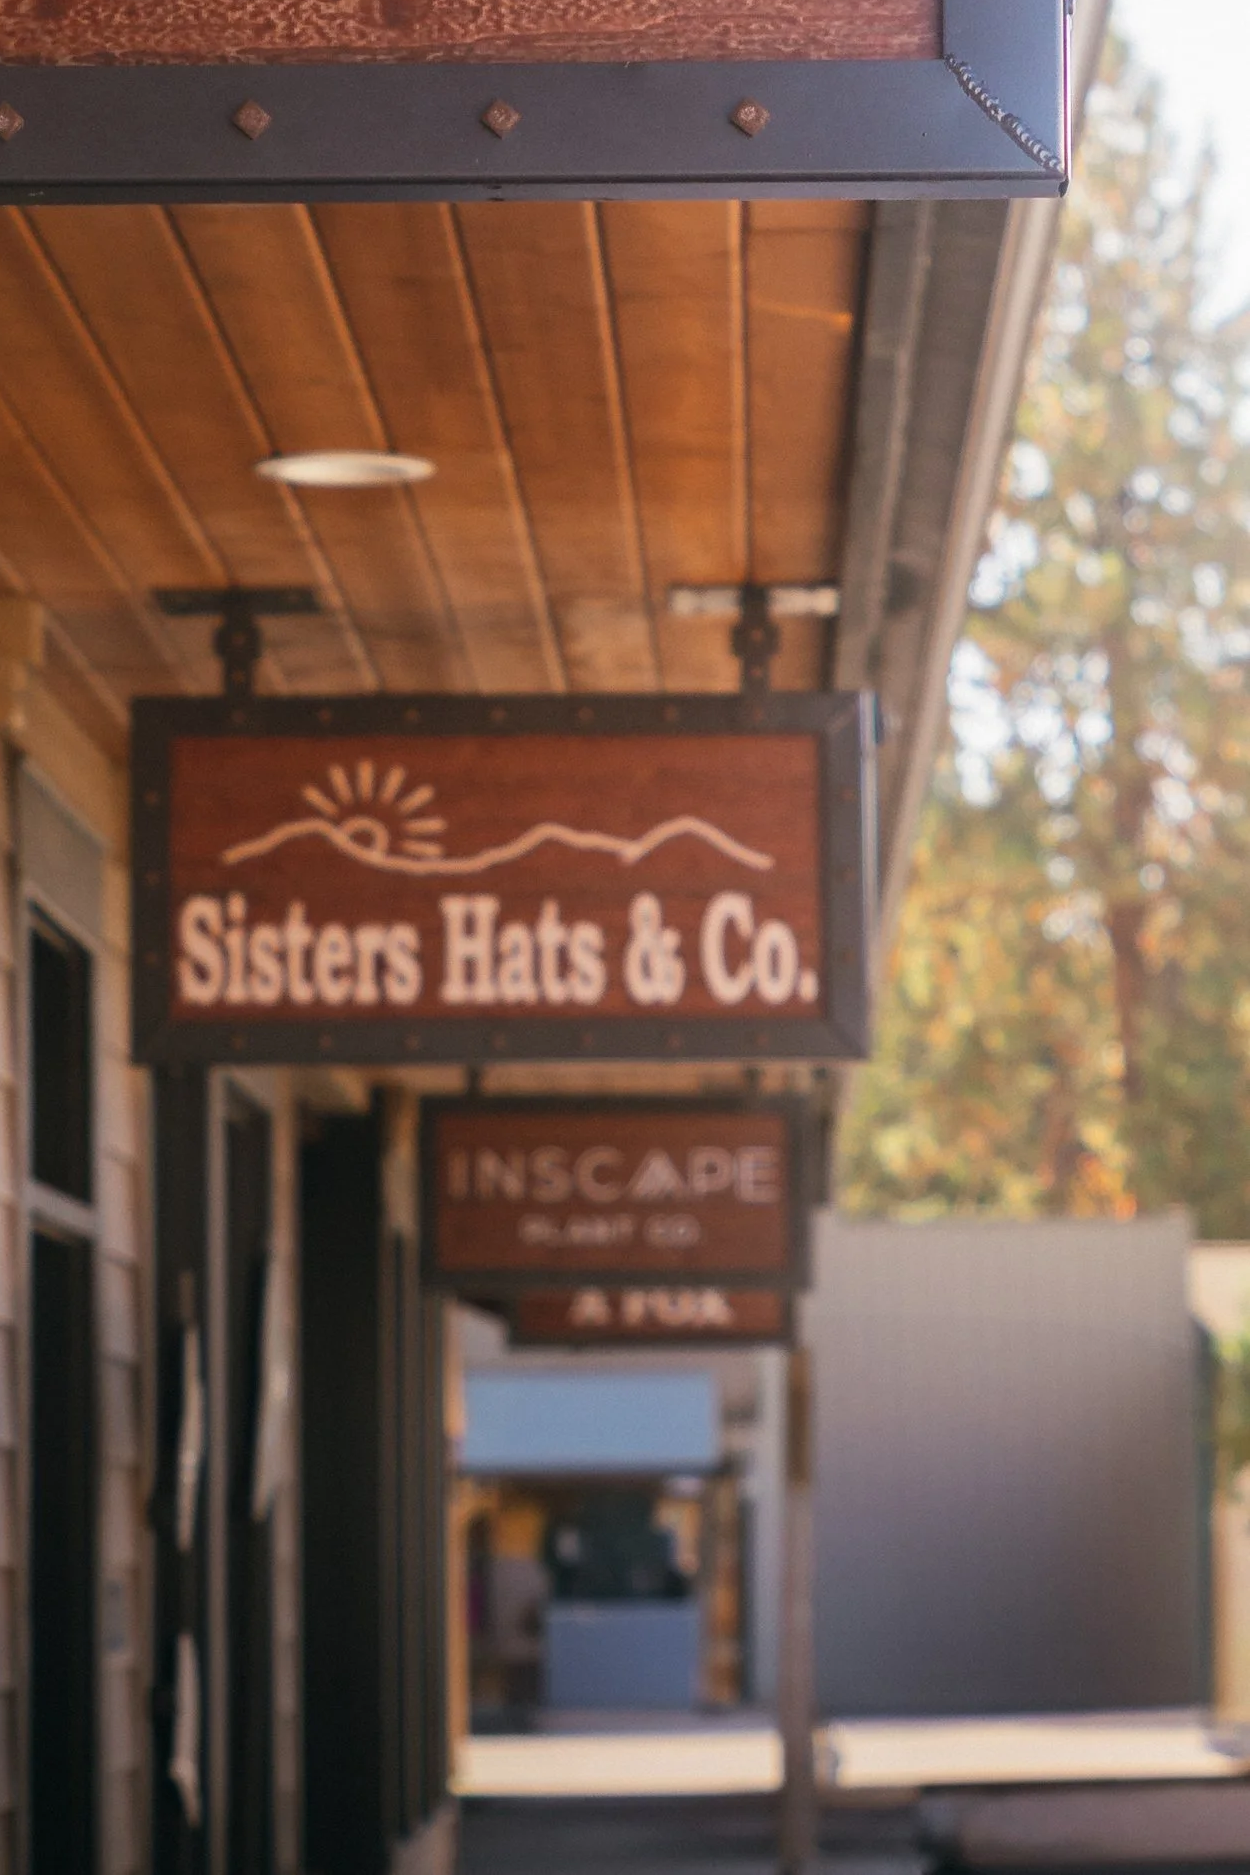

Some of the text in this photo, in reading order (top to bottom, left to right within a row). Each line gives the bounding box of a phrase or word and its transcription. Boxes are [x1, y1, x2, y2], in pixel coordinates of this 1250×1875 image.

[178, 892, 819, 1006] Sisters Hats & Co.
[448, 1145, 782, 1205] INSCAPE
